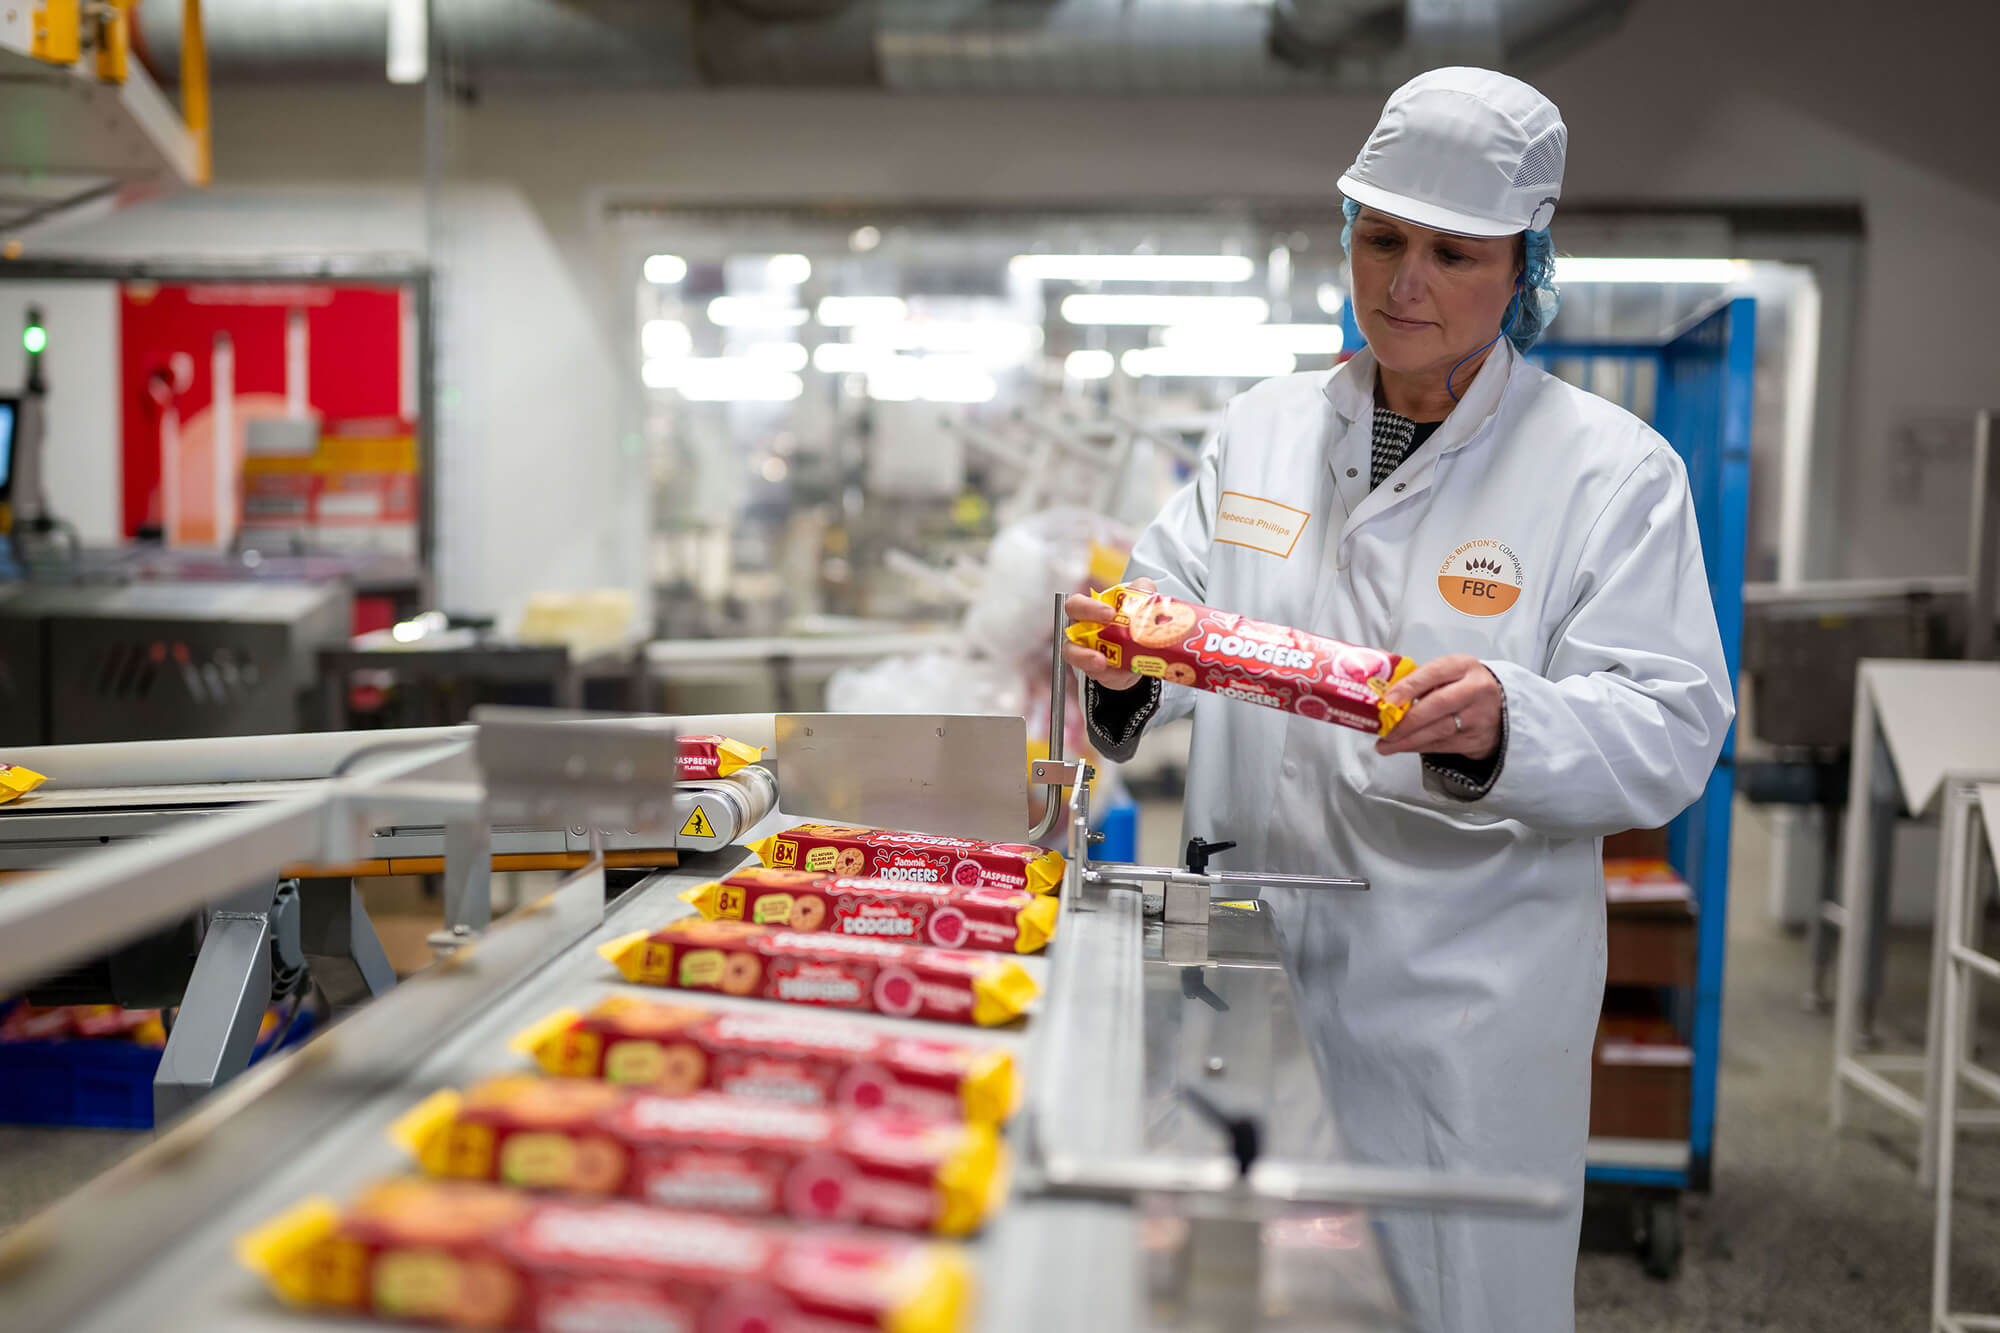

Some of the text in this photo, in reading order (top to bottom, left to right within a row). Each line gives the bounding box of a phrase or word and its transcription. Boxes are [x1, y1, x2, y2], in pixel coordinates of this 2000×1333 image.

[1222, 511, 1290, 536] Rebecca Phillips
[1455, 539, 1498, 556] BURTON'S
[1498, 543, 1524, 586] COMPANIES
[1461, 580, 1498, 599] FBC
[1204, 632, 1315, 669] DODGERS
[1215, 685, 1281, 708] DODGERS
[894, 857, 926, 867] Jammie
[880, 867, 939, 882] DODGERS
[980, 870, 1026, 887] RASPBERRY
[843, 916, 914, 935] DODGERS
